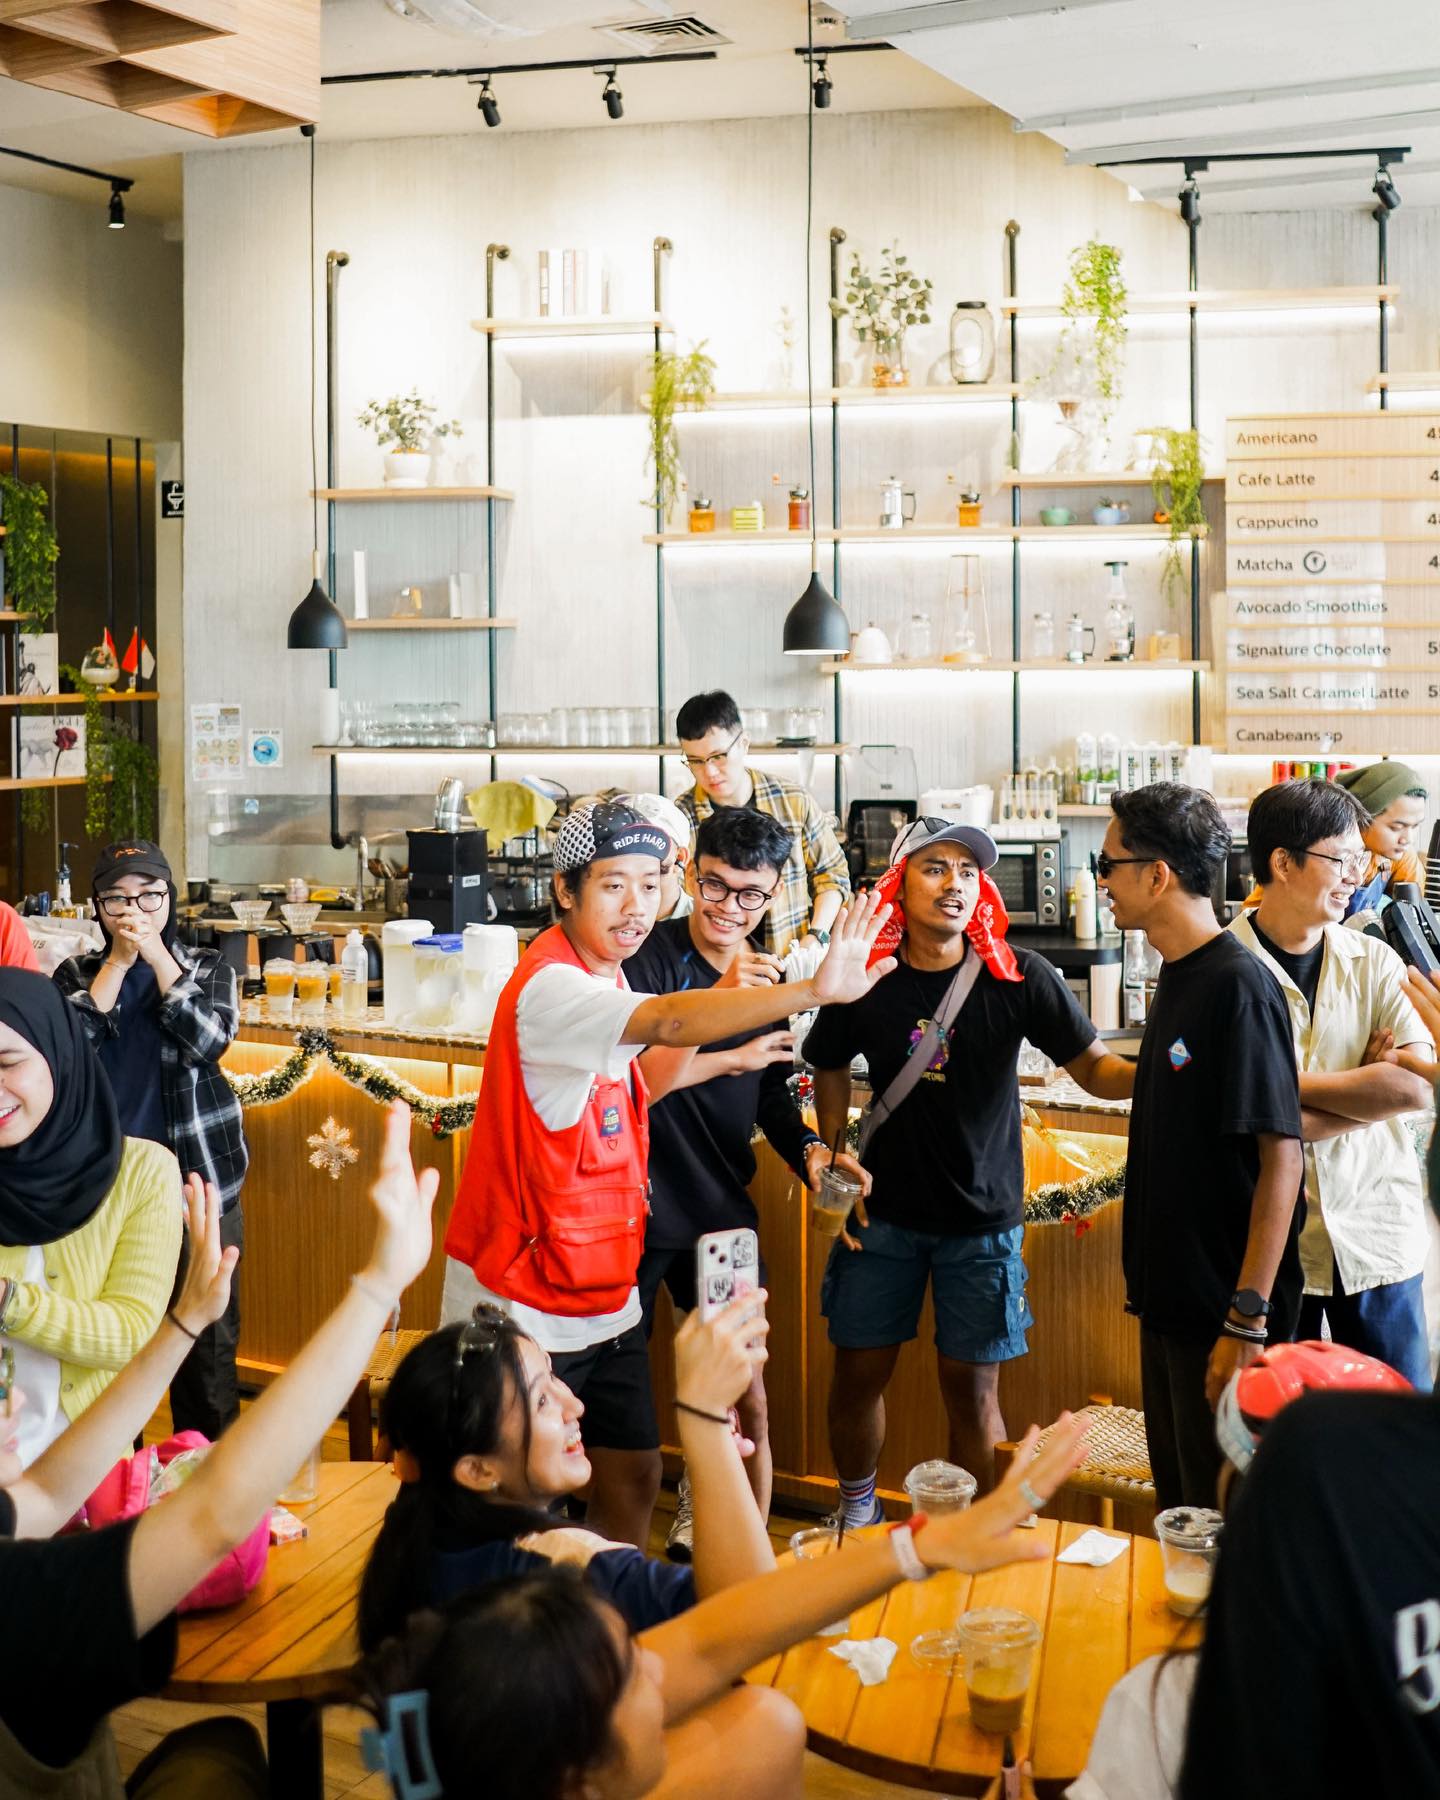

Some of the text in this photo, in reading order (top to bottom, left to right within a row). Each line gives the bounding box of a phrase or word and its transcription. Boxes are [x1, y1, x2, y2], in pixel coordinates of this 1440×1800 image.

[1237, 427, 1440, 445] Americano 4
[1238, 473, 1272, 487] Cafe
[1277, 472, 1315, 486] Latte
[1237, 513, 1440, 531] Cappucino 4
[1237, 555, 1440, 571] Matcha 4
[1236, 599, 1388, 614] Avocado Smoothies
[1237, 641, 1440, 658] Signature Chocolate 5
[1237, 685, 1440, 700] Sea Salt Caramel Latte 5
[1236, 729, 1321, 742] Canabeans
[612, 833, 667, 850] RIDE HARD
